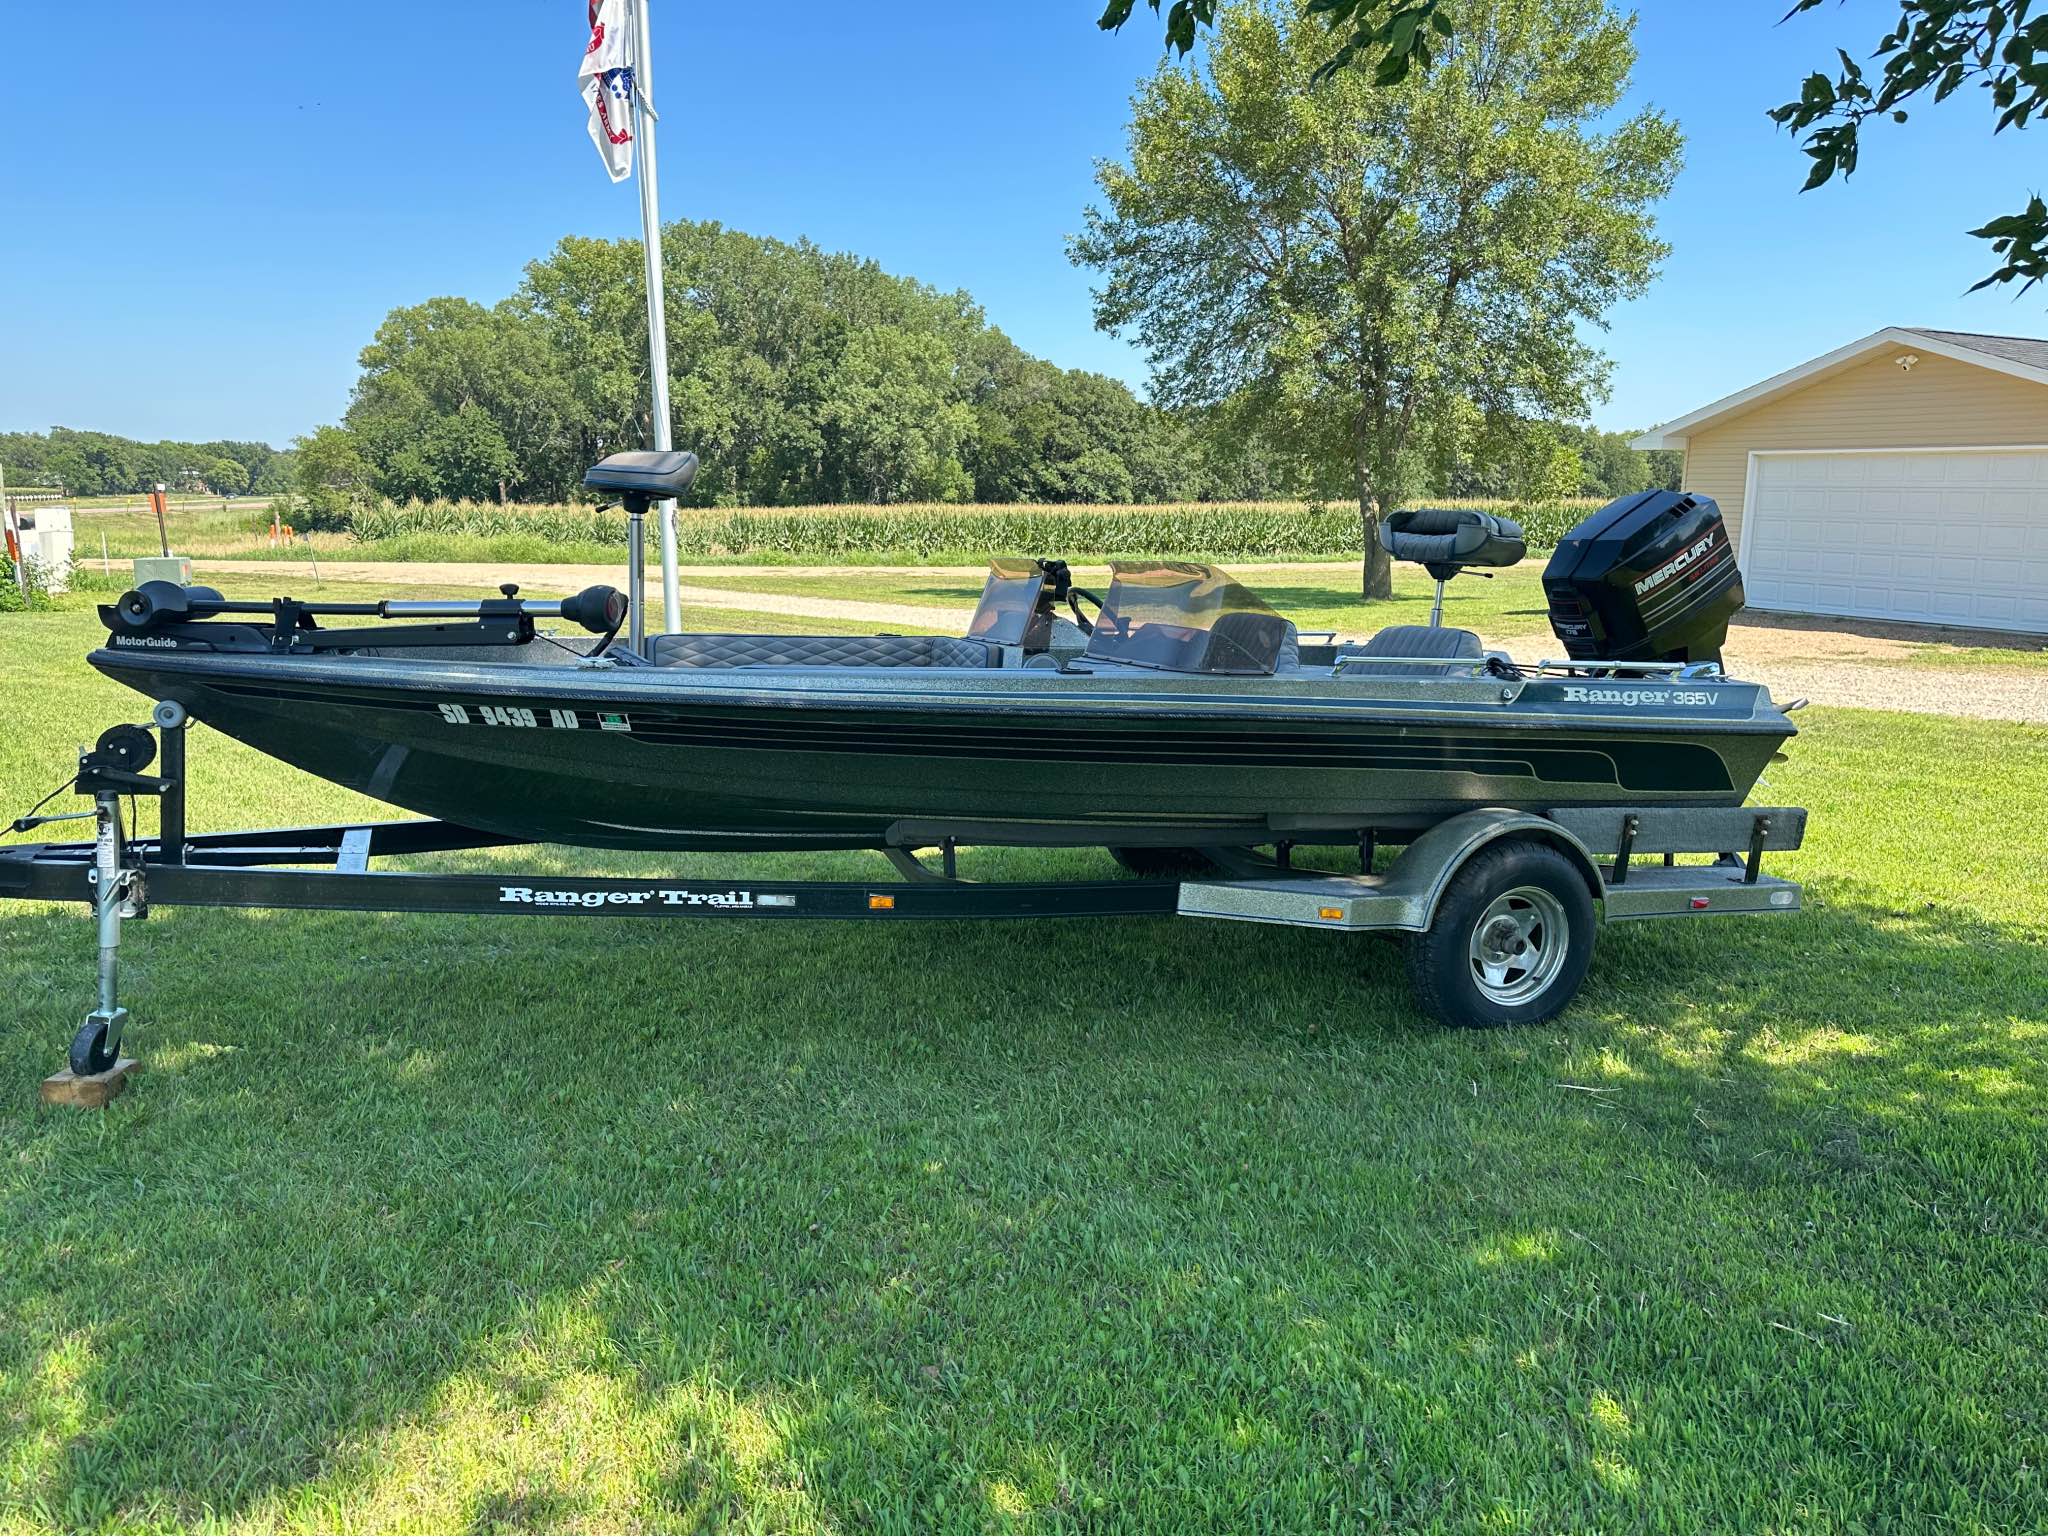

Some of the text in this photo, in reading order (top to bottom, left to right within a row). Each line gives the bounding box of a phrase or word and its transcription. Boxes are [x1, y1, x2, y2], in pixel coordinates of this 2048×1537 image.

[1634, 531, 1714, 596] MERCURY
[116, 635, 178, 648] MotorGuide
[1563, 687, 1719, 706] Ranger 365V
[438, 703, 470, 724] SD
[479, 706, 537, 728] 9439
[499, 886, 754, 907] Ranger Trail
